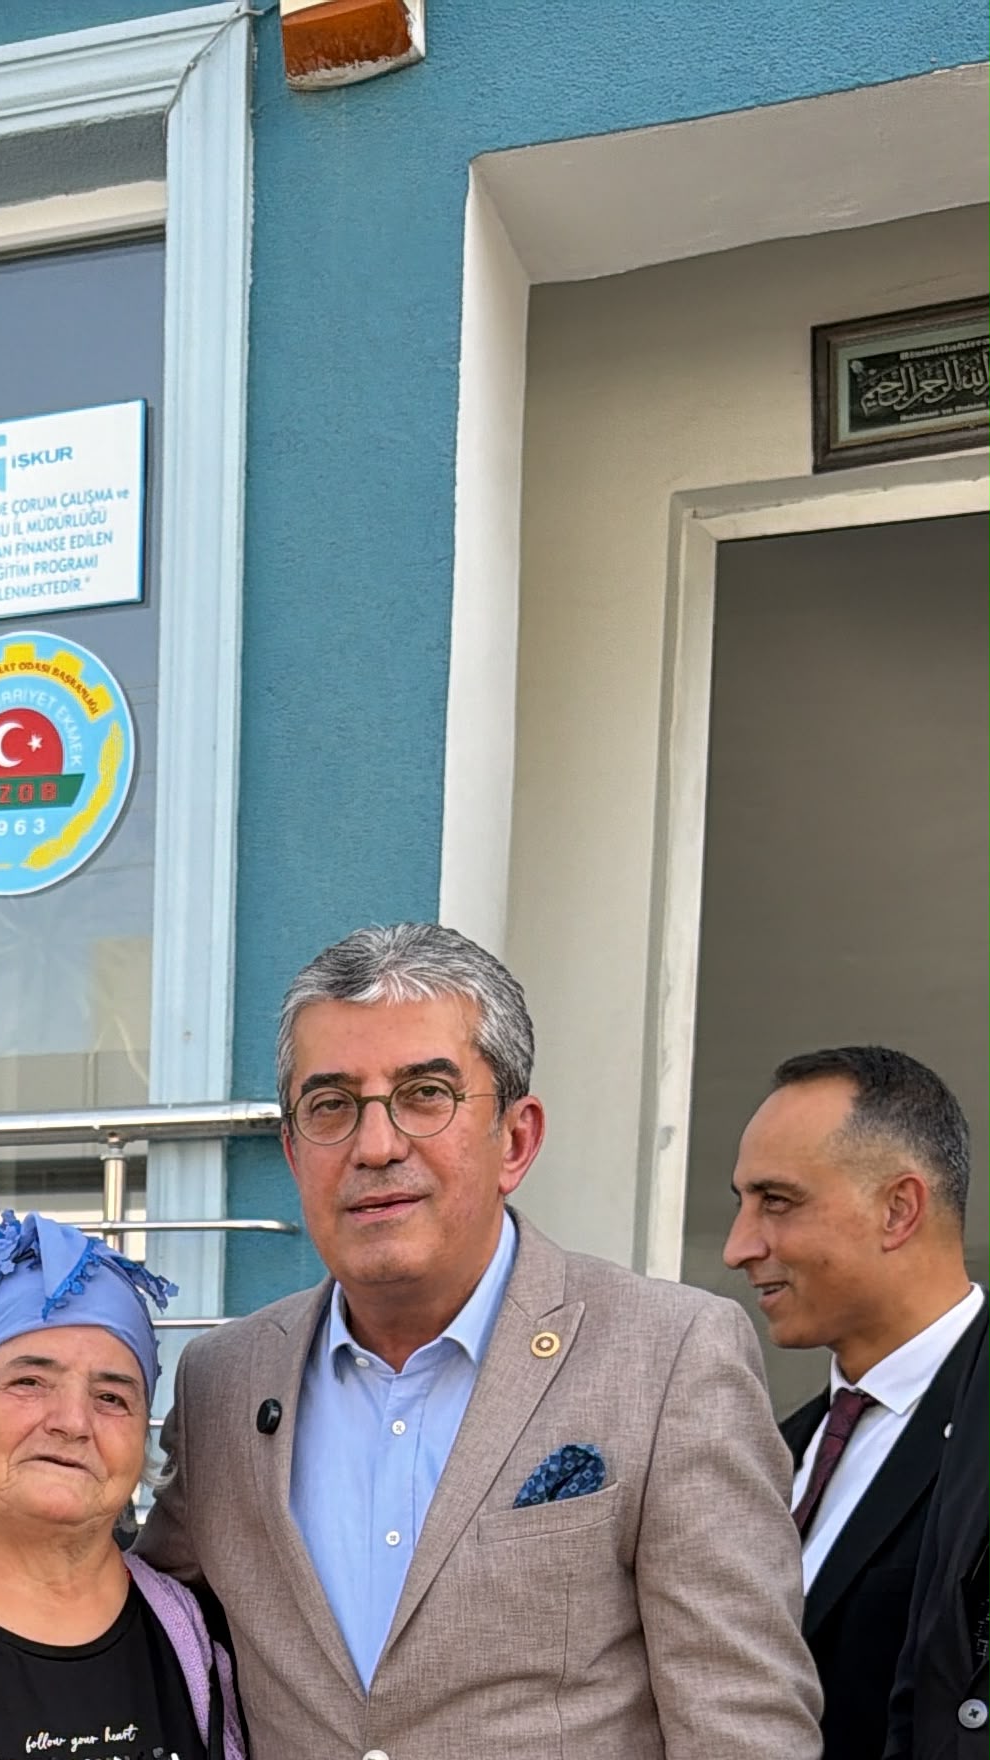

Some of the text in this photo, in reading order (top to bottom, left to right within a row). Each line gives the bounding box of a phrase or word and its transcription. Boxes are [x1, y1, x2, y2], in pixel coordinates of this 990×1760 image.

[12, 495, 57, 519] ÇORUM
[60, 487, 114, 512] ÇALIŞMA
[116, 488, 130, 500] ve
[13, 517, 23, 536] İL
[27, 506, 108, 533] MÜDÜRLÜĞÜ
[15, 536, 66, 556] FİNANSE
[69, 529, 114, 550] EDİLEN
[18, 661, 50, 674] ODASI
[54, 702, 83, 767] EKMEK
[25, 1724, 140, 1754] follow your heart
